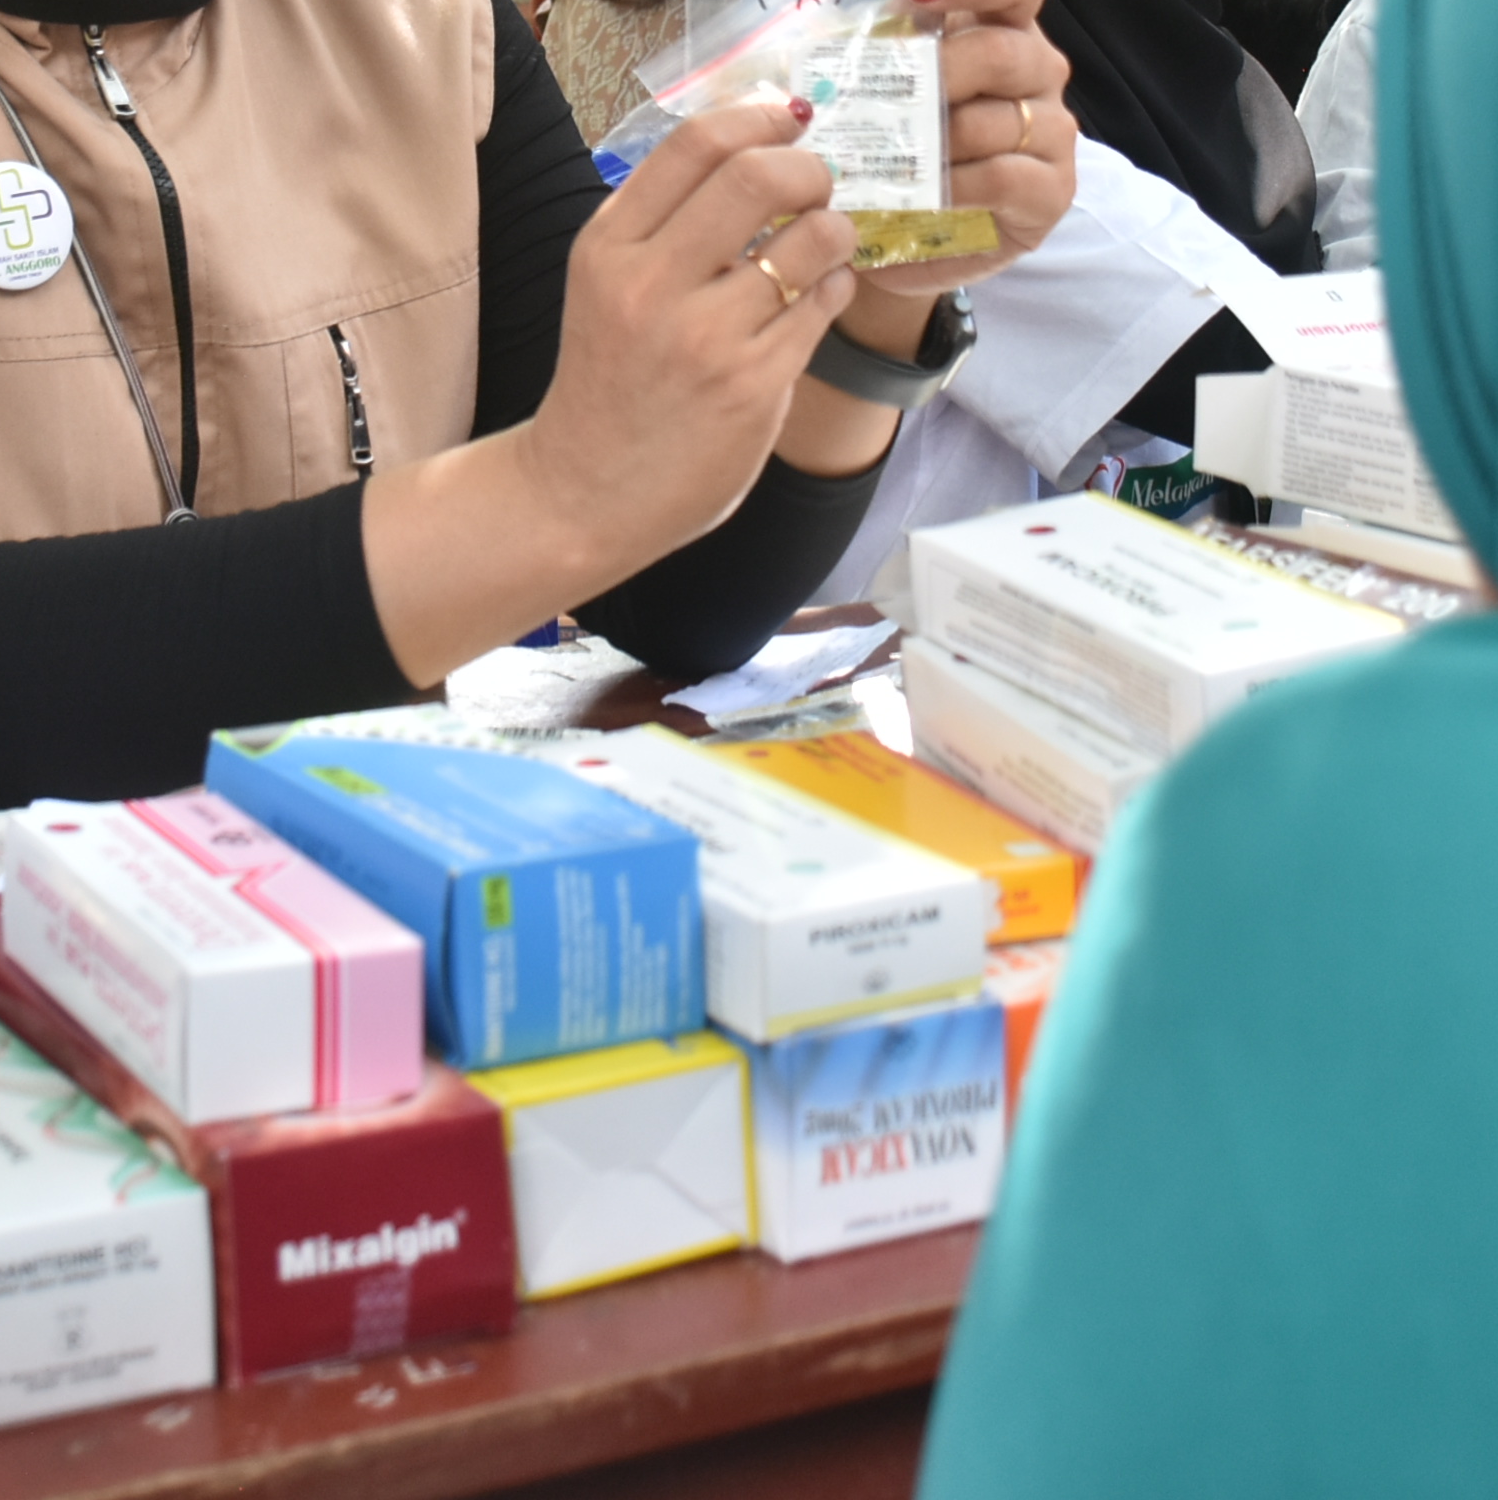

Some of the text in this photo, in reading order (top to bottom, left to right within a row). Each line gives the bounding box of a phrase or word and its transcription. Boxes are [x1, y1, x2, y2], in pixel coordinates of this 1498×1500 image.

[5, 256, 61, 275] ANGGORO
[1381, 583, 1461, 621] 200
[808, 903, 939, 945] PIROXICAM
[820, 1124, 977, 1186] NOVAXICAM
[277, 1213, 461, 1283] Mixalgin
